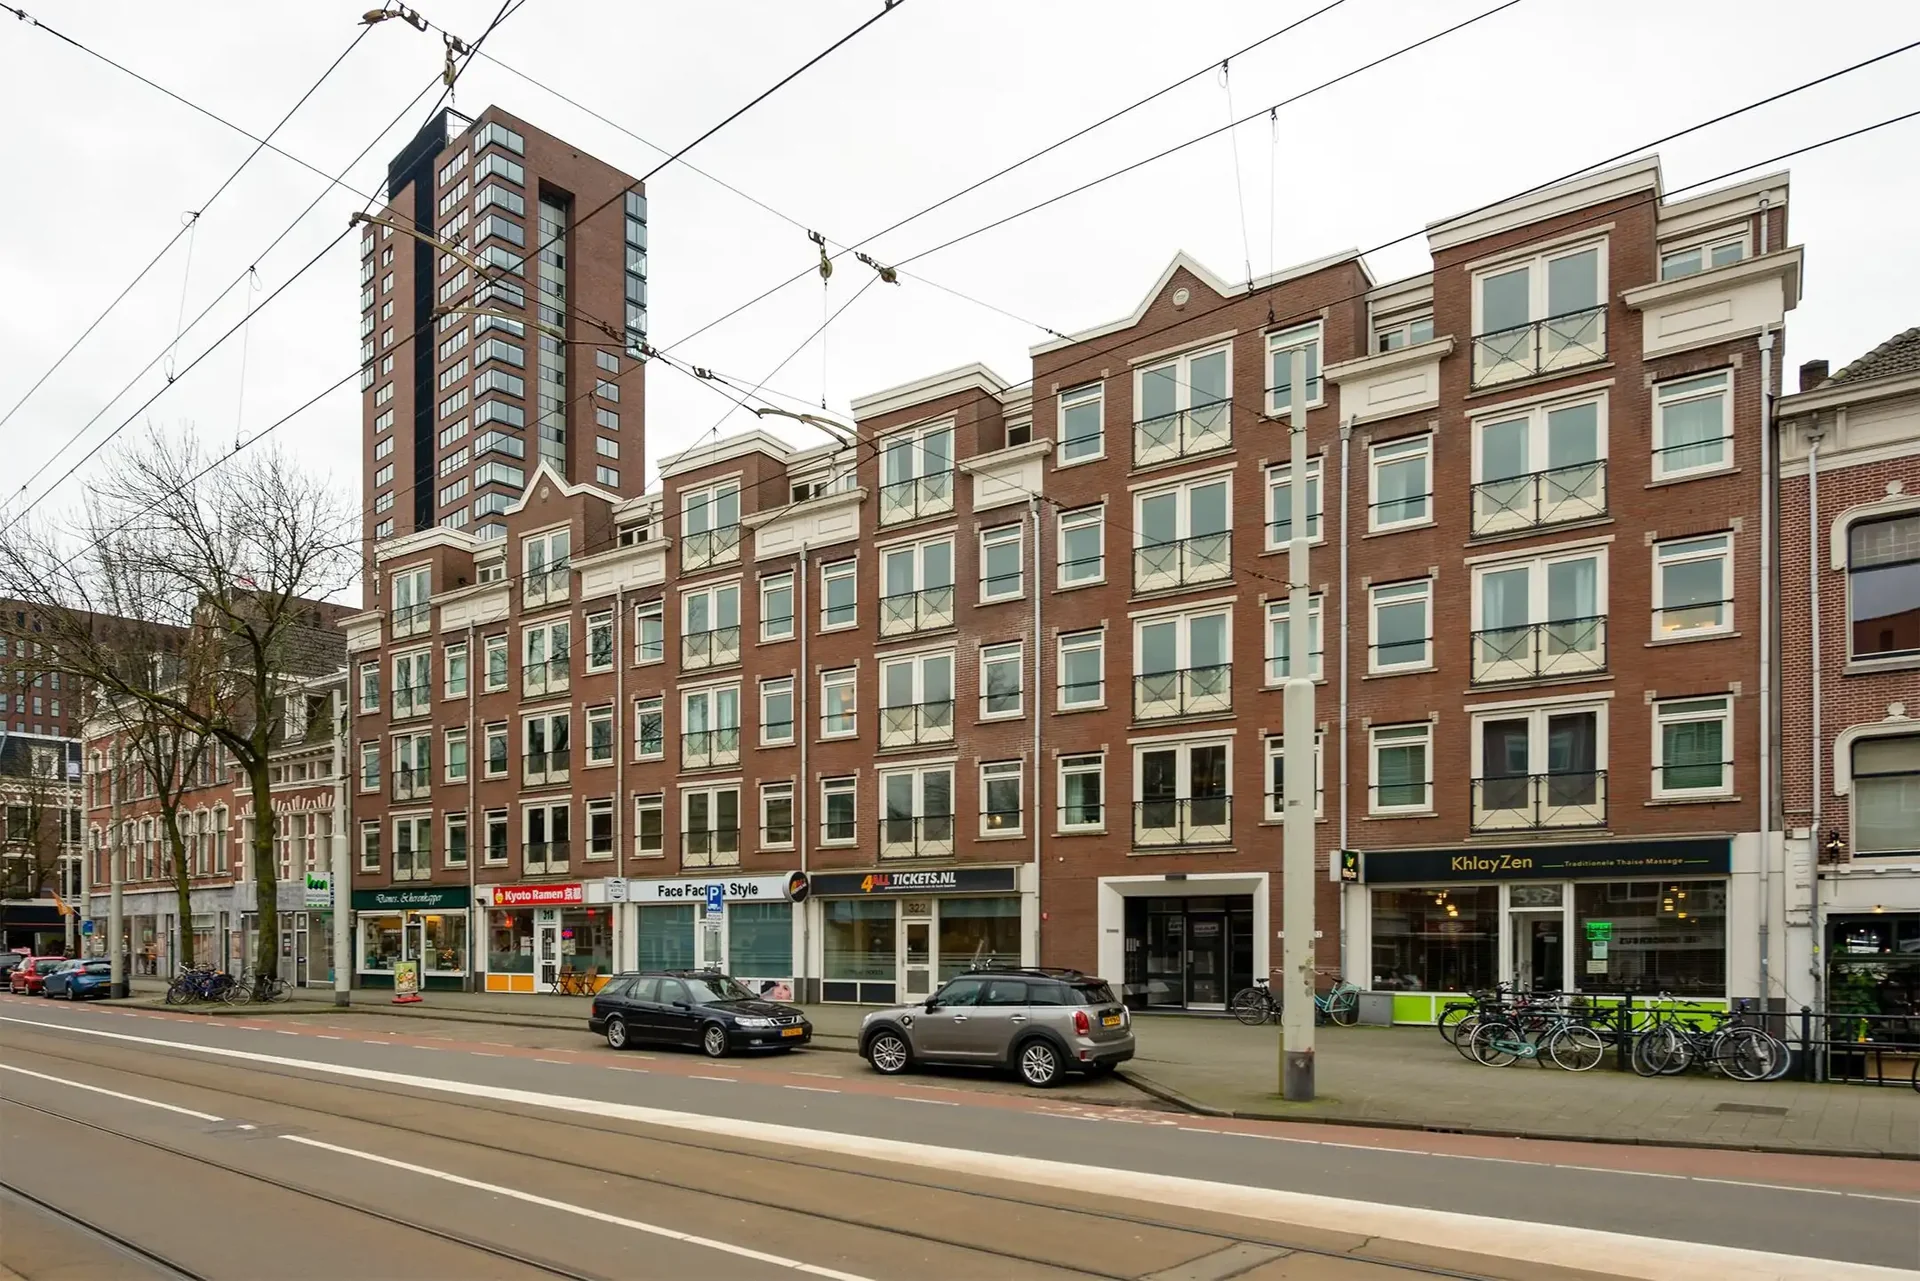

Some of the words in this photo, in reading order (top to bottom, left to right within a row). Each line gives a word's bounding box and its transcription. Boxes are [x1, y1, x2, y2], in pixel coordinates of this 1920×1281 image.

[1451, 854, 1533, 873] KhlayZen
[893, 872, 956, 885] TICKETS.NL
[505, 891, 531, 903] Kyoto
[532, 890, 563, 900] Ramen
[658, 885, 683, 896] Face
[685, 884, 709, 896] Fact
[729, 882, 759, 898] Style
[709, 886, 720, 901] P
[908, 903, 926, 914] 322
